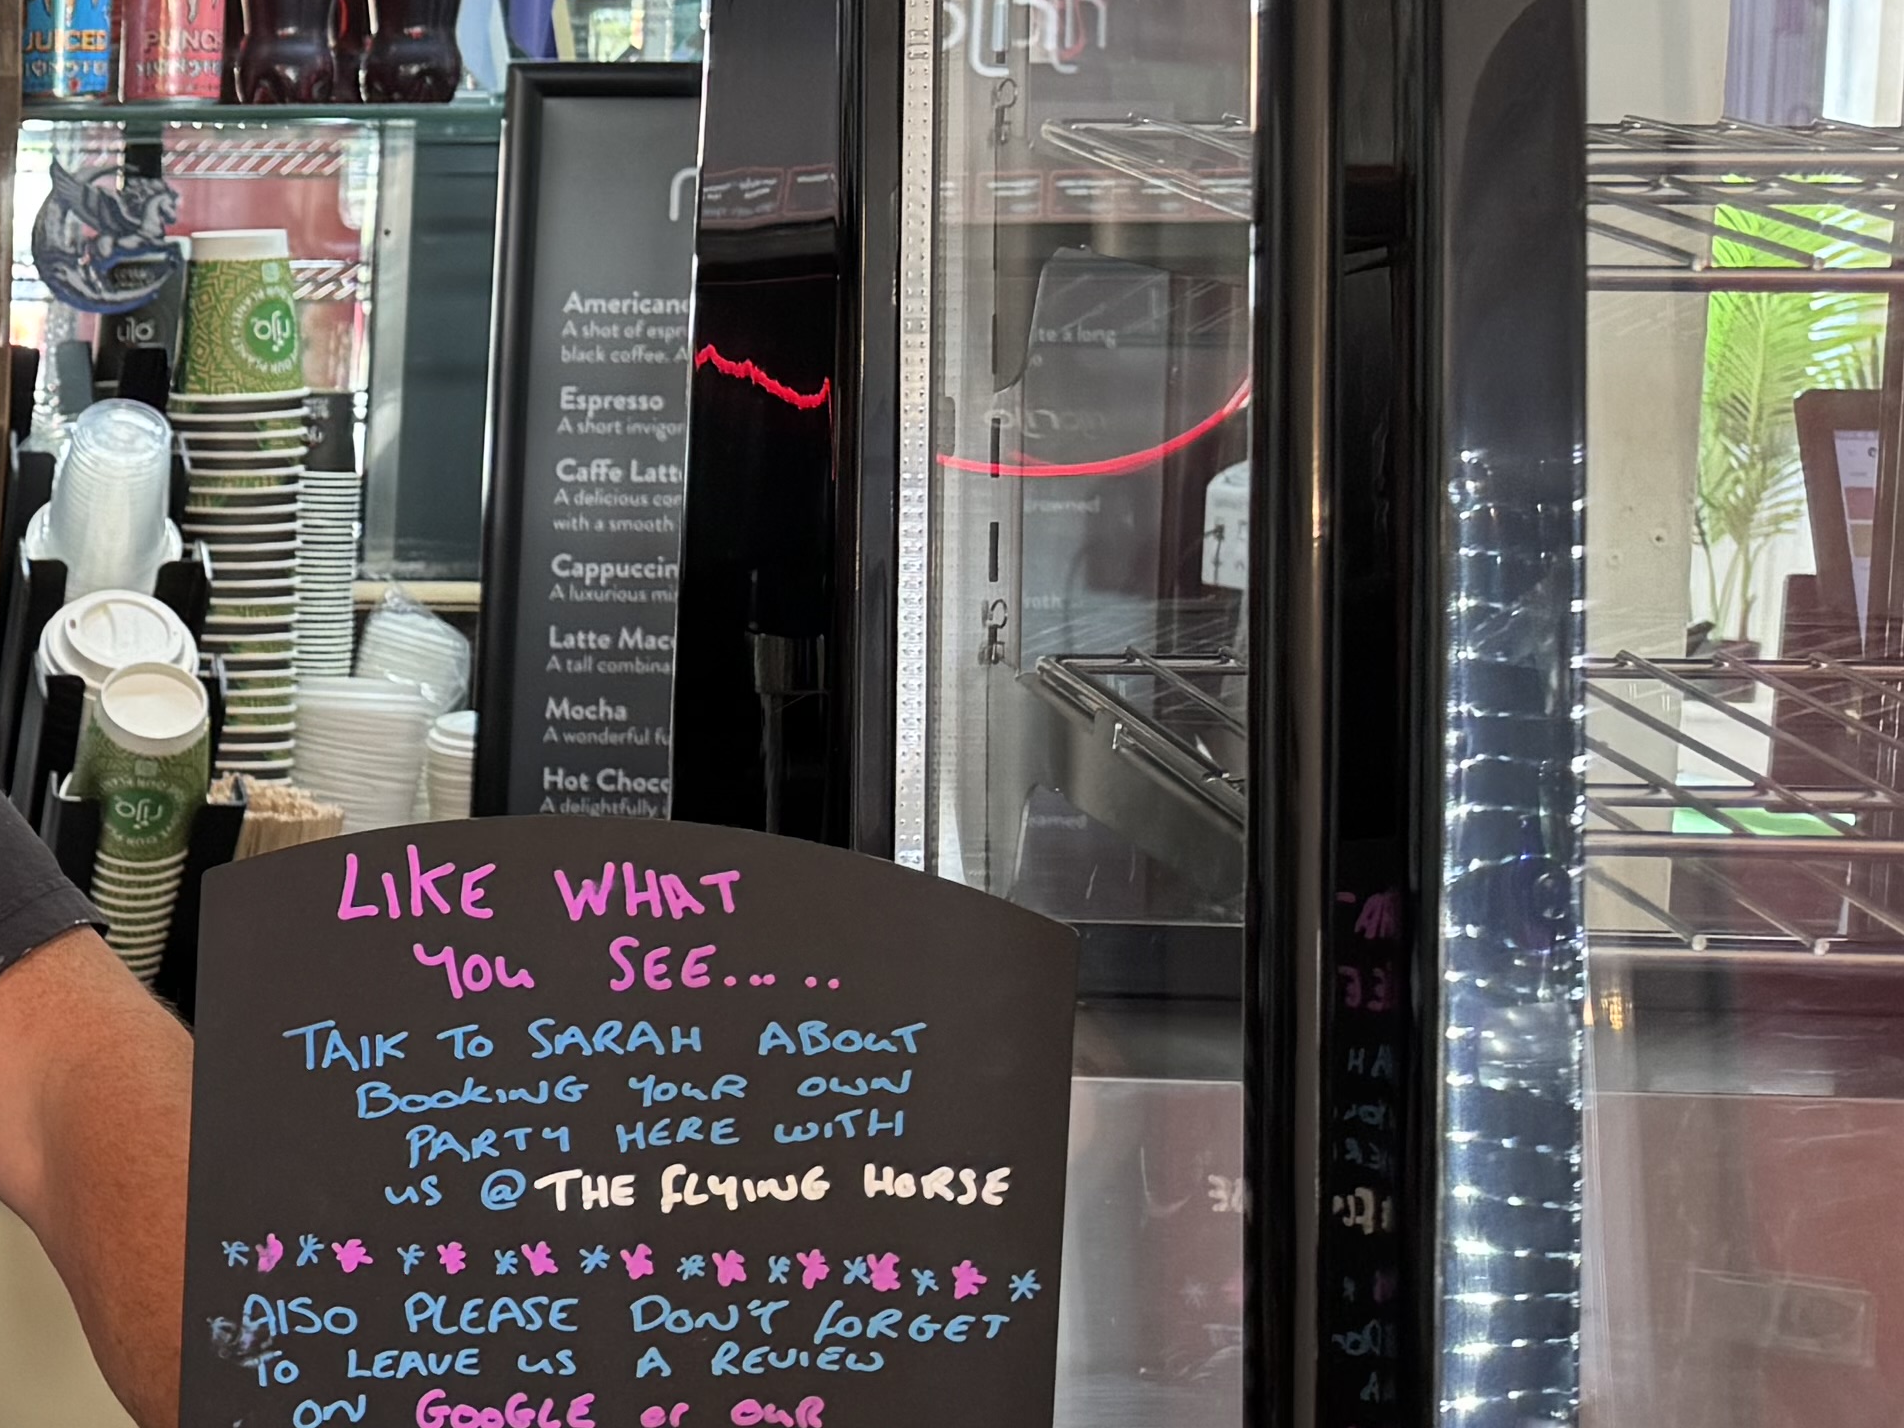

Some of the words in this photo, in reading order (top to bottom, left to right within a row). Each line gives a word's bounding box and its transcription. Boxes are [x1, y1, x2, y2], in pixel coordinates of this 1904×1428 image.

[25, 30, 107, 52] JUICED
[561, 320, 578, 339] A
[581, 320, 620, 339] shot
[623, 320, 642, 339] of
[560, 345, 605, 363] black
[610, 344, 669, 364] coffee.
[559, 386, 665, 419] Espresso
[556, 416, 574, 435] A
[577, 417, 623, 435] short
[555, 458, 623, 484] Caffe
[553, 488, 570, 506] A
[573, 488, 649, 507] delicious
[553, 514, 590, 533] with
[594, 519, 605, 532] a
[609, 513, 675, 533] smooth
[548, 583, 565, 601] A
[569, 583, 647, 603] luxurious
[549, 625, 613, 649] Latte
[545, 654, 562, 672] A
[566, 655, 593, 673] tall
[597, 656, 674, 674] combina
[545, 696, 628, 722] Mocha
[543, 726, 559, 743] A
[563, 726, 650, 746] wonderful
[543, 766, 591, 792] Hot
[540, 795, 556, 814] A
[560, 796, 658, 818] delightfully
[337, 844, 496, 921] LIKE
[555, 861, 741, 922] WHAT
[413, 942, 535, 1000] YOU
[437, 1024, 494, 1062] TO
[530, 1018, 703, 1057] SARAH
[758, 1020, 926, 1057] ABOUT
[628, 1073, 748, 1107] YOUR
[796, 1068, 912, 1097] OWN
[407, 1125, 571, 1168] PARTY
[617, 1118, 740, 1154] HERE
[773, 1107, 904, 1144] WITH
[864, 1164, 1012, 1205] HORSE
[405, 1295, 579, 1334] PLEASE
[632, 1297, 790, 1338] DON'T
[814, 1305, 1010, 1344] FORGET
[347, 1347, 481, 1380] LEAVE
[636, 1346, 673, 1378] A
[711, 1343, 885, 1376] REVIEW
